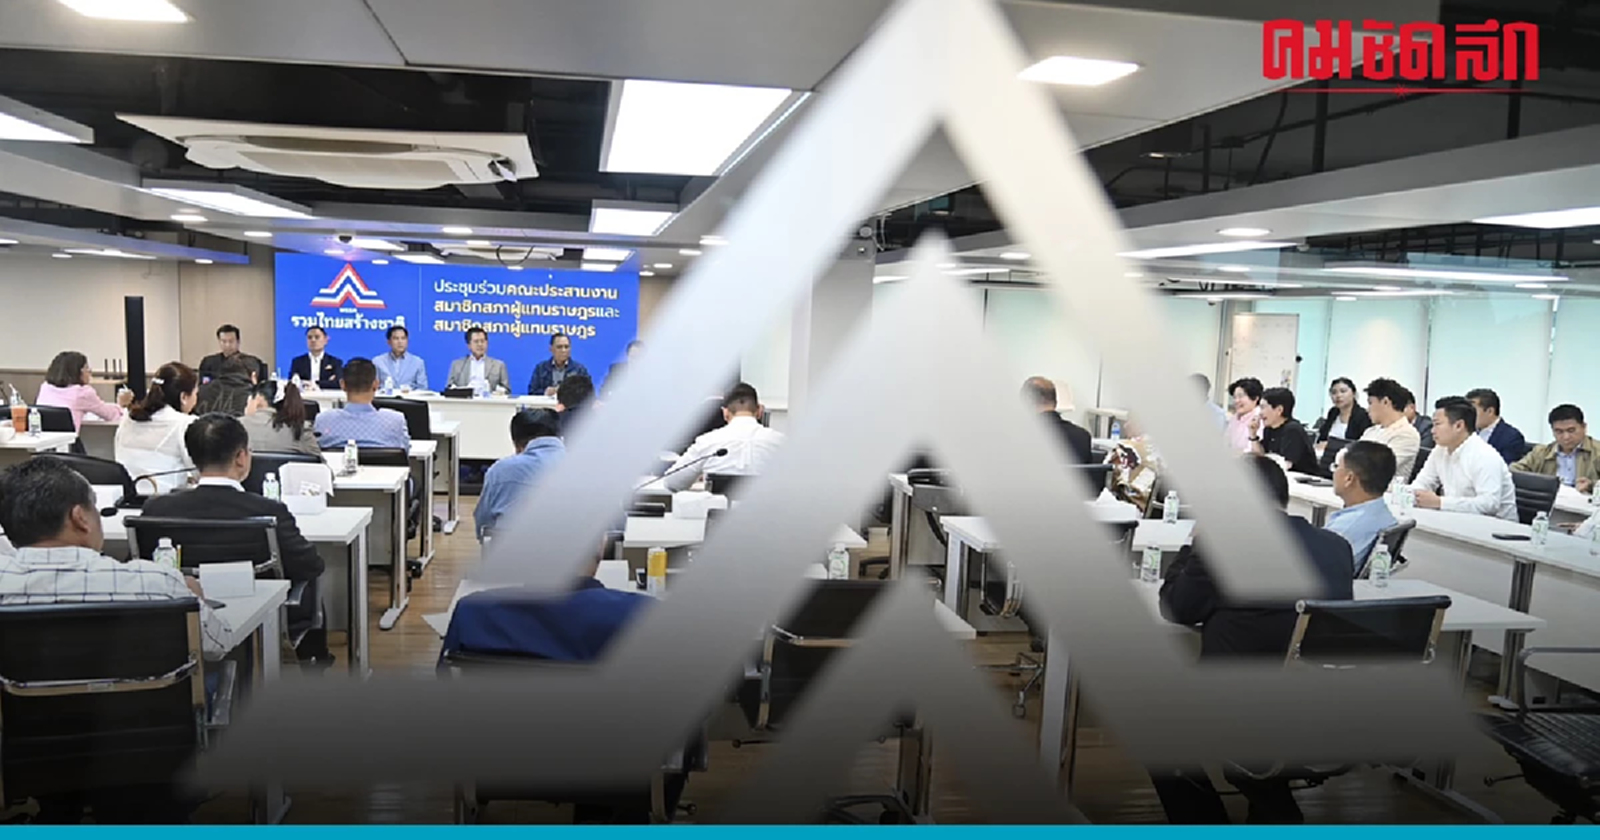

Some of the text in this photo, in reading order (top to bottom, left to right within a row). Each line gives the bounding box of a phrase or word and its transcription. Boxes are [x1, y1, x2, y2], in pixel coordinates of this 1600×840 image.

[434, 278, 618, 300] ประชุมร่วมคณะประสานงาน
[291, 311, 405, 329] รวมไทยสร้างชาติ
[433, 300, 620, 320] สมาชิกสภาผู้แทนราษฎรและ
